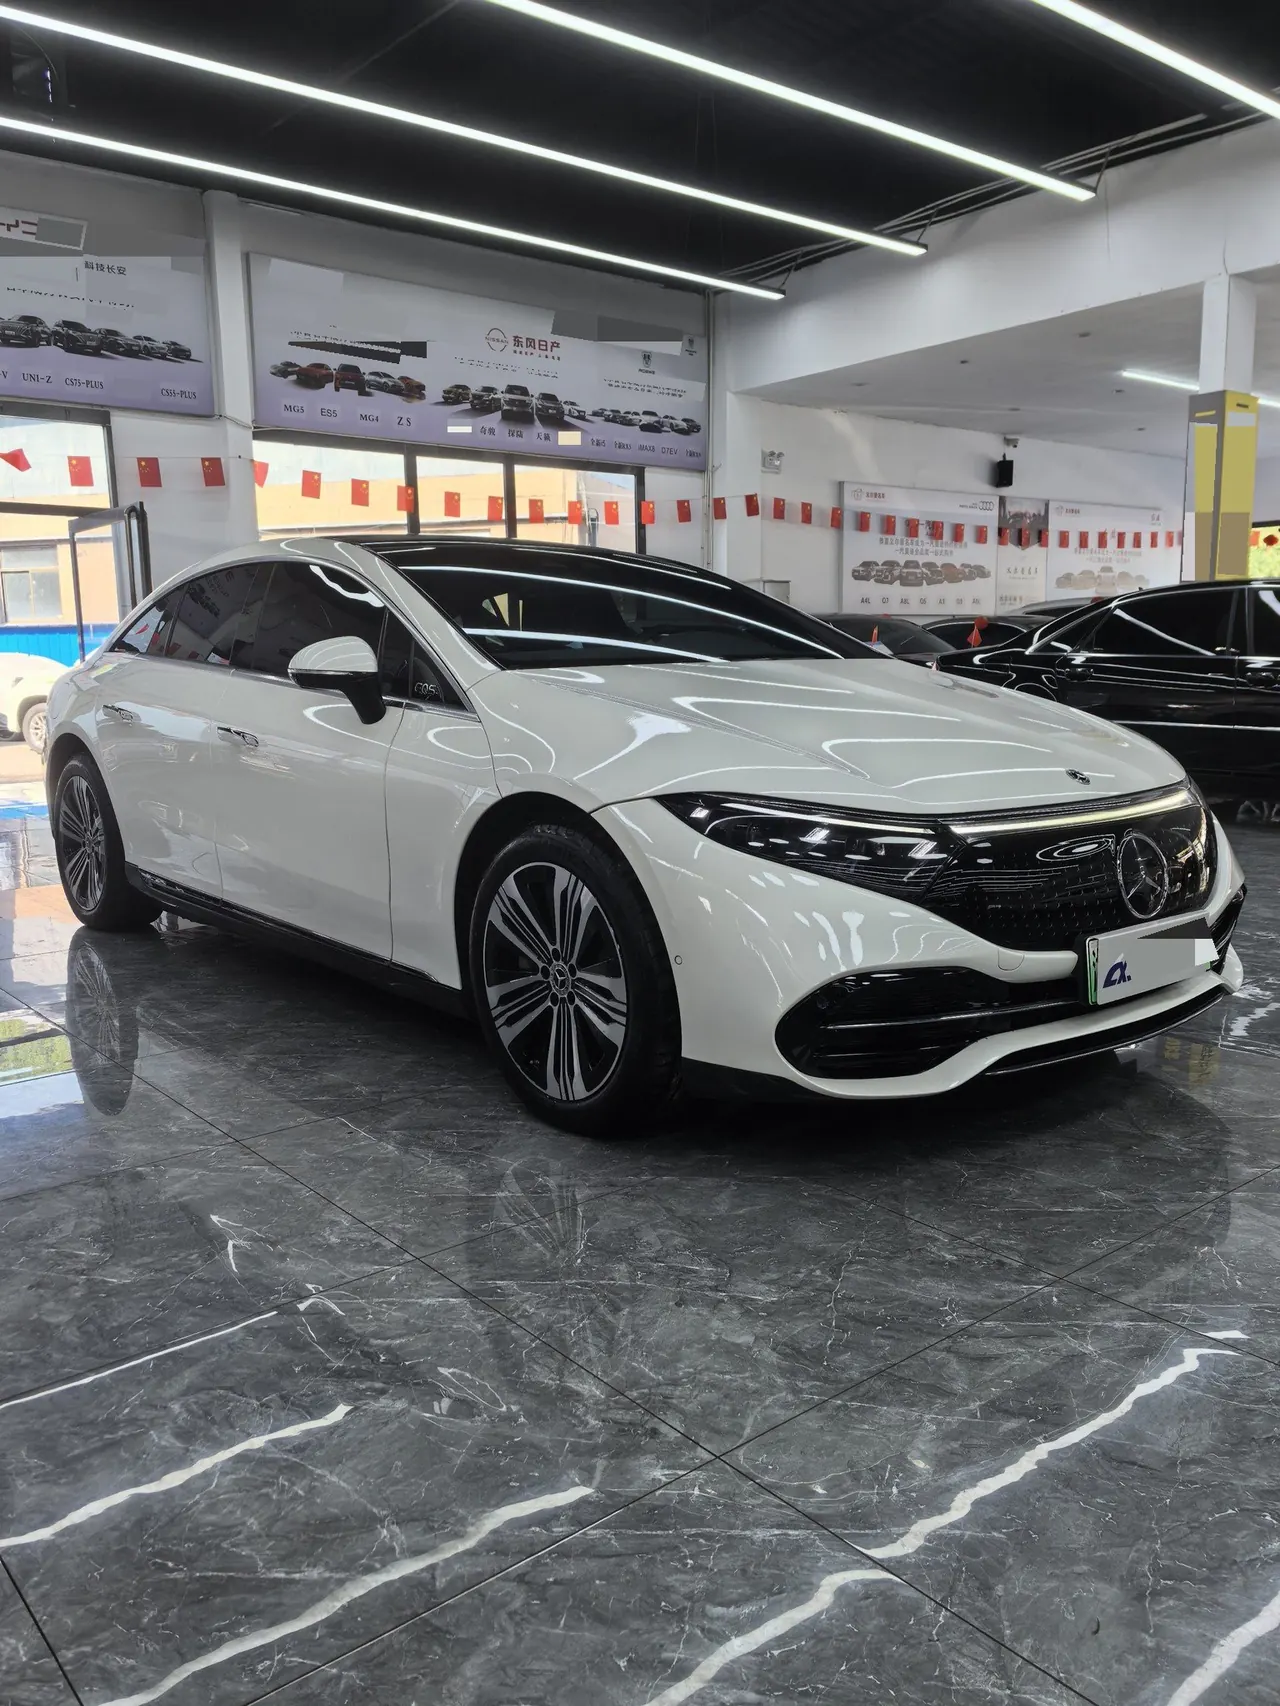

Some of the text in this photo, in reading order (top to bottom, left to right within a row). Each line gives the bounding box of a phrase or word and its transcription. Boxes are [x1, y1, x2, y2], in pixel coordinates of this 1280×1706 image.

[84, 260, 127, 276] 科技长安
[485, 336, 509, 344] NISSAN
[513, 335, 561, 352] 东风日产
[22, 373, 53, 384] UNI-Z
[65, 377, 104, 390] CS75-PLUS
[161, 388, 197, 399] CS55-PLUS
[283, 404, 305, 413] MG5
[320, 408, 338, 417] ES5
[360, 414, 379, 422] MG4
[479, 426, 496, 436] 奇骏
[508, 428, 524, 439] 探陆
[661, 447, 678, 455] D7EV
